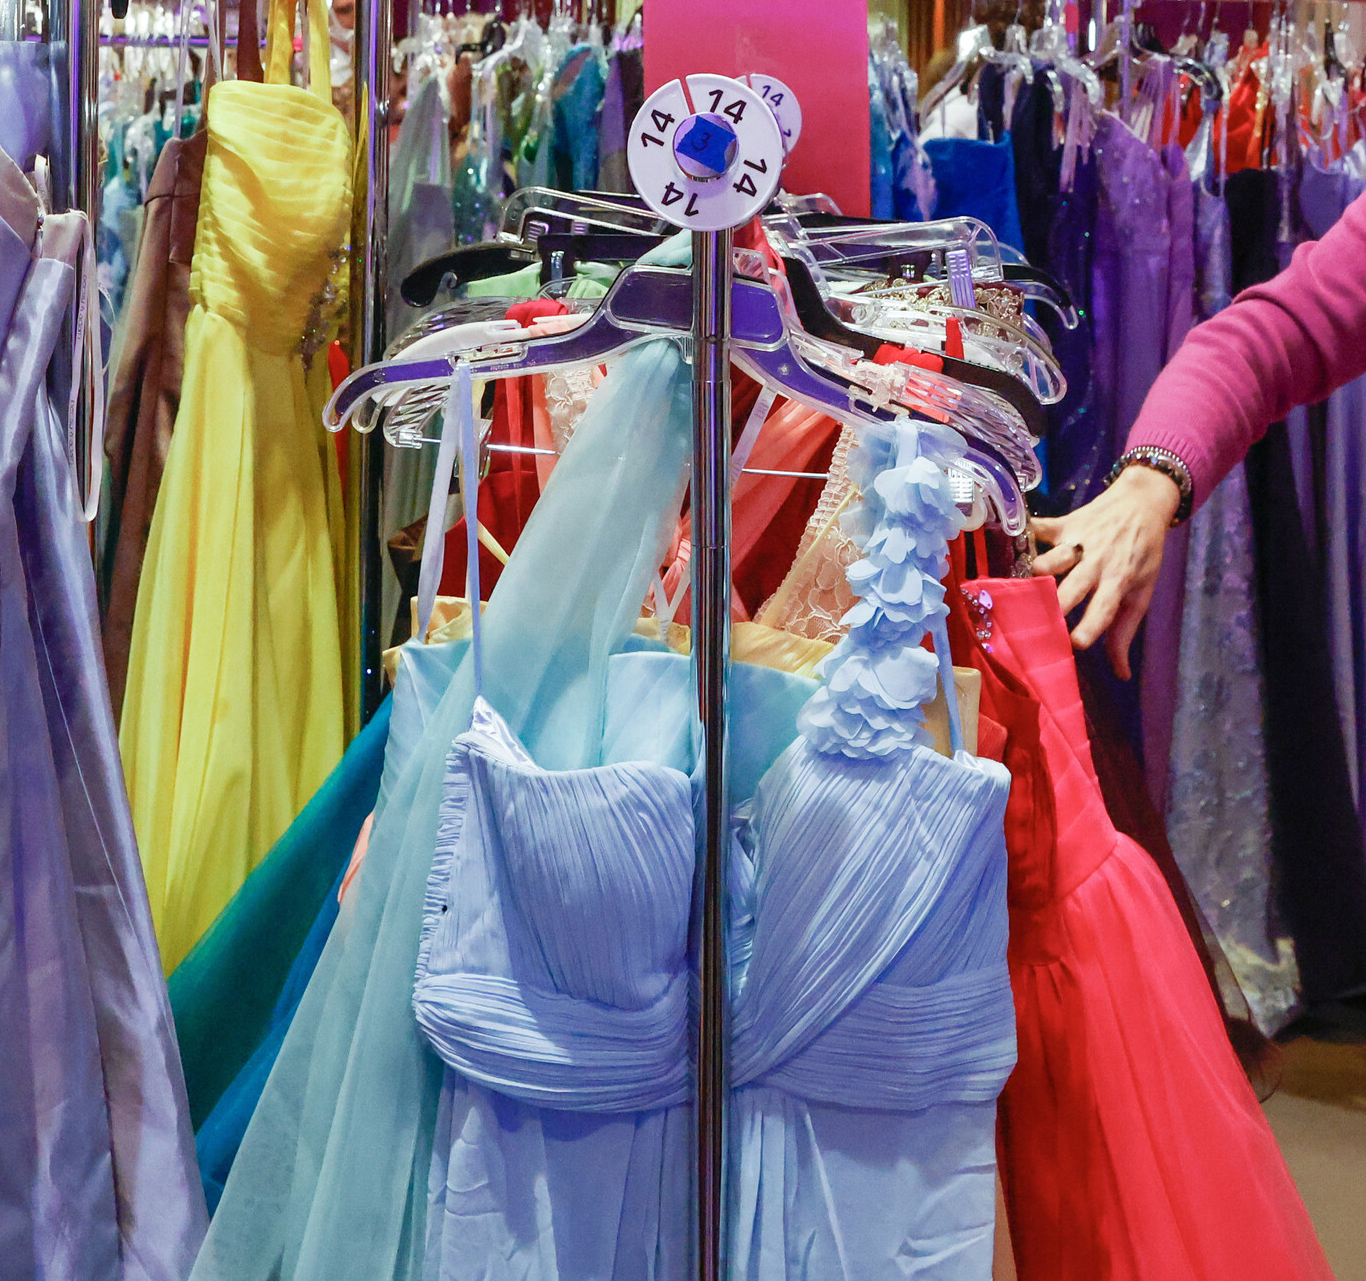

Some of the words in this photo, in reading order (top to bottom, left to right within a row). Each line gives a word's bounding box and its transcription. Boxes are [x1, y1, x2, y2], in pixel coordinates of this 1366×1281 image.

[708, 88, 748, 125] 14
[761, 84, 785, 108] 14
[640, 108, 676, 148] 14
[690, 131, 712, 153] 3
[732, 158, 768, 198] 14
[660, 181, 700, 218] 14
